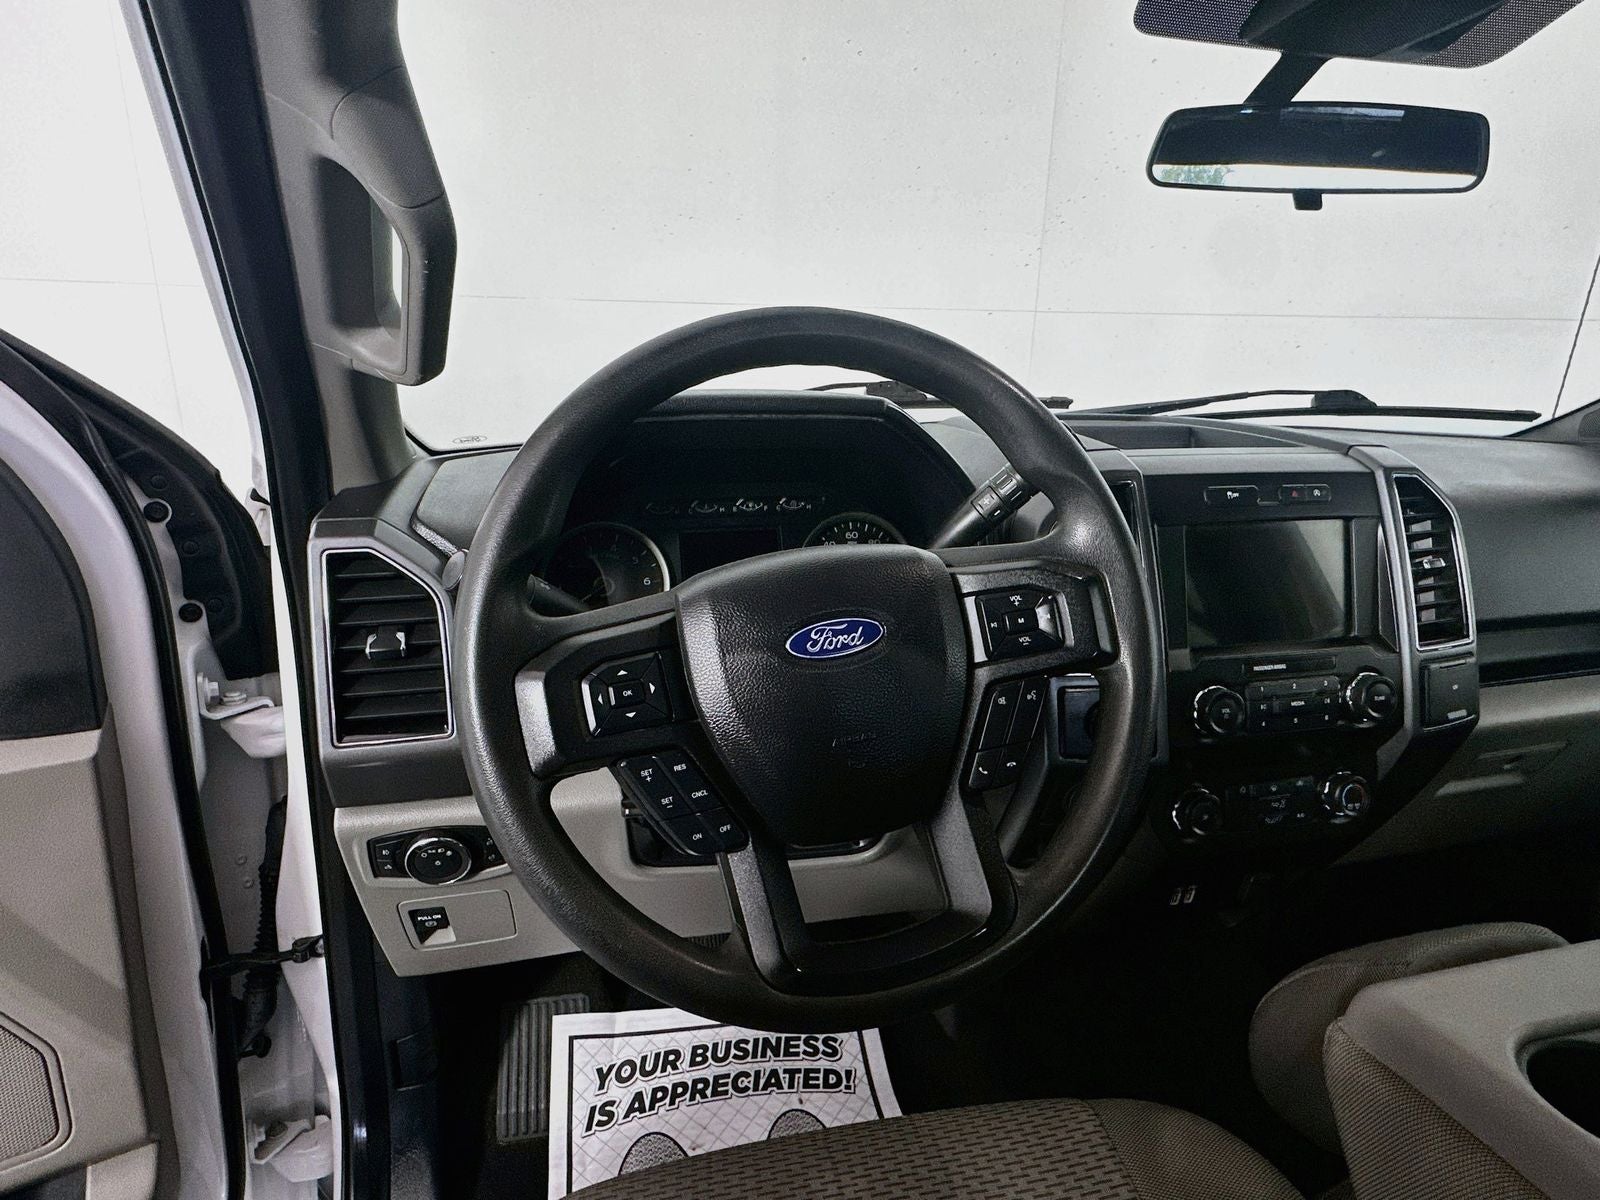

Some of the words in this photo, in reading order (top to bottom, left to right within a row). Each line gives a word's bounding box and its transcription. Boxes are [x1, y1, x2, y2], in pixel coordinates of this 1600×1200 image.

[845, 530, 859, 540] 60
[643, 576, 651, 586] 6
[806, 623, 864, 653] Ford
[1018, 635, 1032, 643] VOL
[622, 689, 633, 697] OK
[673, 763, 687, 772] RES
[640, 768, 653, 777] SET
[691, 789, 709, 799] CNCL
[661, 796, 673, 805] SET
[719, 824, 732, 833] OFF
[692, 832, 703, 841] ON
[595, 1049, 682, 1092] YOUR
[688, 1035, 842, 1069] BUSINESS
[585, 1099, 617, 1134] IS
[623, 1067, 855, 1120] APPRECIATED!
